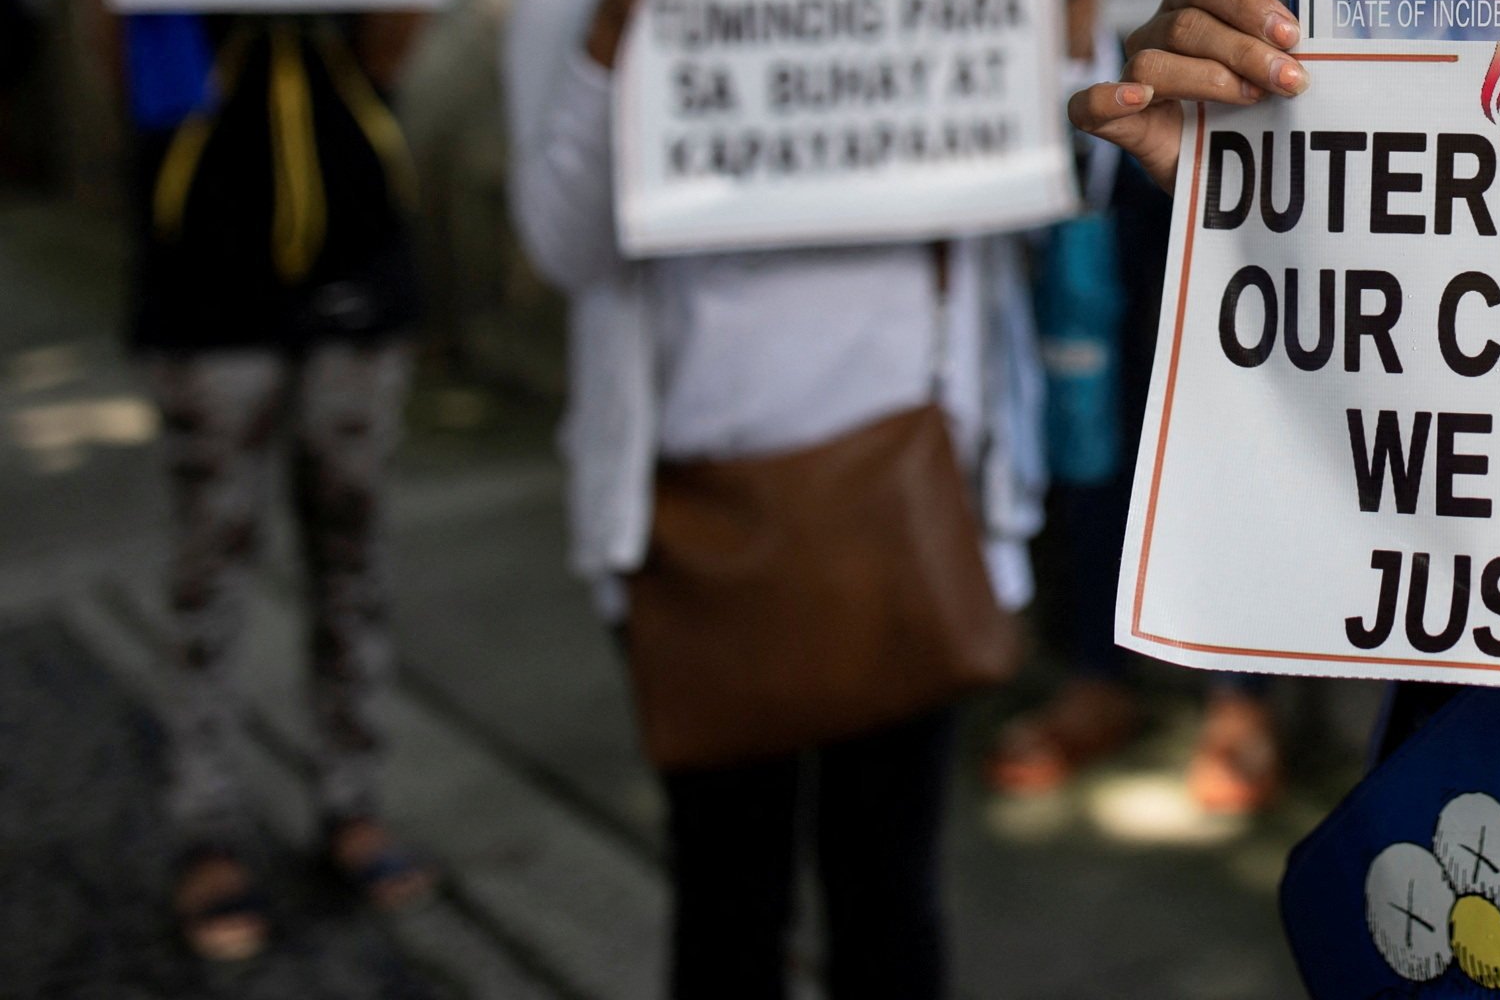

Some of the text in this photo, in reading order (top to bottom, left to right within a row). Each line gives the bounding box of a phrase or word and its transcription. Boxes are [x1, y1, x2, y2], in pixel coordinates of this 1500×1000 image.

[1336, 0, 1391, 28] DATE
[1397, 0, 1426, 28] OF
[1218, 264, 1404, 374] OUR
[1345, 408, 1493, 519] WE
